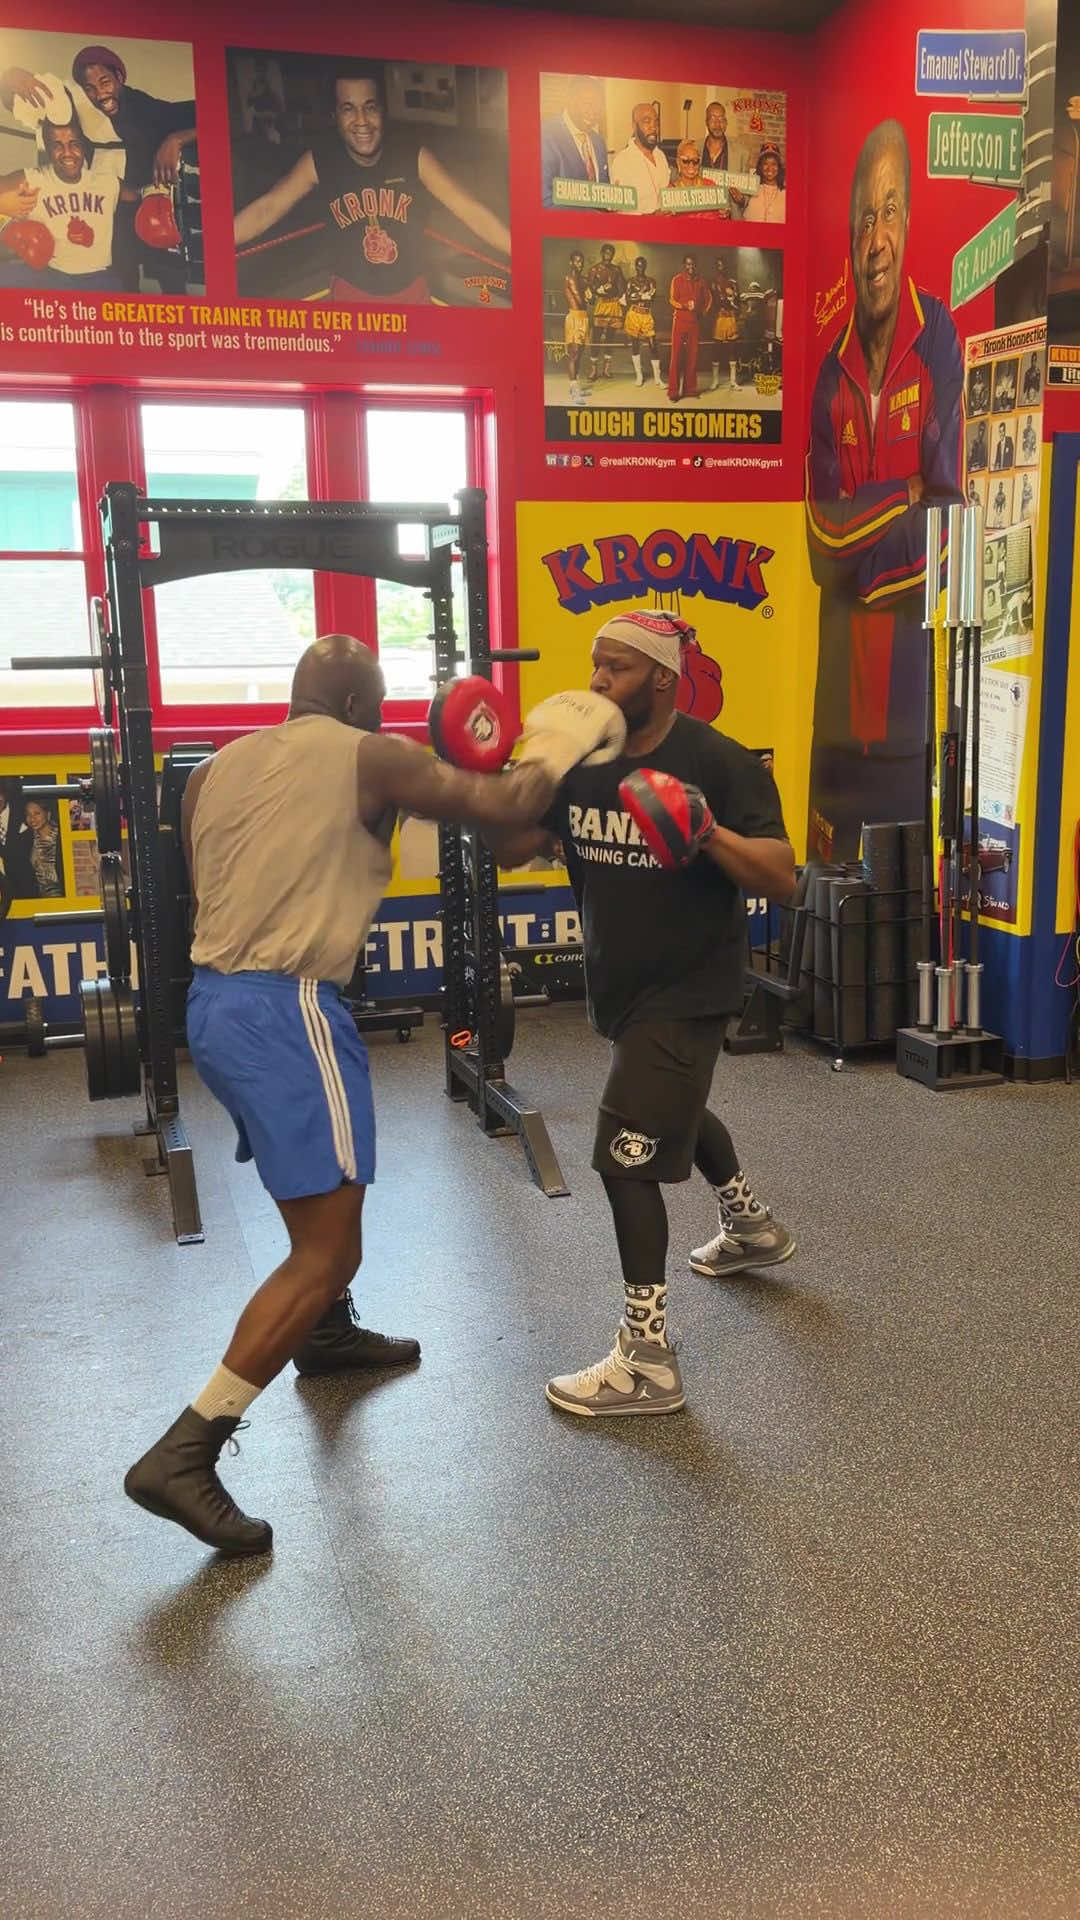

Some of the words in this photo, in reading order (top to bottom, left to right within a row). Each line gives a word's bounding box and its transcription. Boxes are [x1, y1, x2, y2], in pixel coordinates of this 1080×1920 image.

[921, 47, 962, 81] Emanuel
[963, 48, 1007, 81] Steward
[1008, 47, 1023, 80] Dr.
[934, 120, 1003, 170] Jefferson
[1009, 128, 1018, 172] E
[42, 191, 105, 219] KRONK
[330, 187, 412, 229] KRONK
[956, 258, 970, 298] St
[971, 226, 1011, 283] Aubin
[24, 297, 67, 320] “He’s
[72, 301, 97, 321] the
[102, 302, 185, 325] GREATEST
[191, 305, 262, 327] TRAINER
[267, 308, 308, 329] THAT
[312, 310, 352, 331] EVER
[357, 312, 408, 333] LIVED!
[19, 324, 114, 346] contribution
[119, 327, 134, 346] to
[139, 327, 164, 347] the
[168, 330, 208, 351] sport
[211, 334, 240, 349] was
[244, 332, 342, 353] tremendous.”
[984, 337, 1006, 354] Kronk
[1051, 347, 1080, 361] KRO
[567, 410, 635, 437] TOUGH
[643, 411, 762, 438] CUSTOMERS
[600, 456, 677, 469] @realKRONKgym
[705, 456, 783, 469] @realKRONKgym1
[212, 534, 353, 560] ROGUE
[541, 529, 775, 615] KRONK
